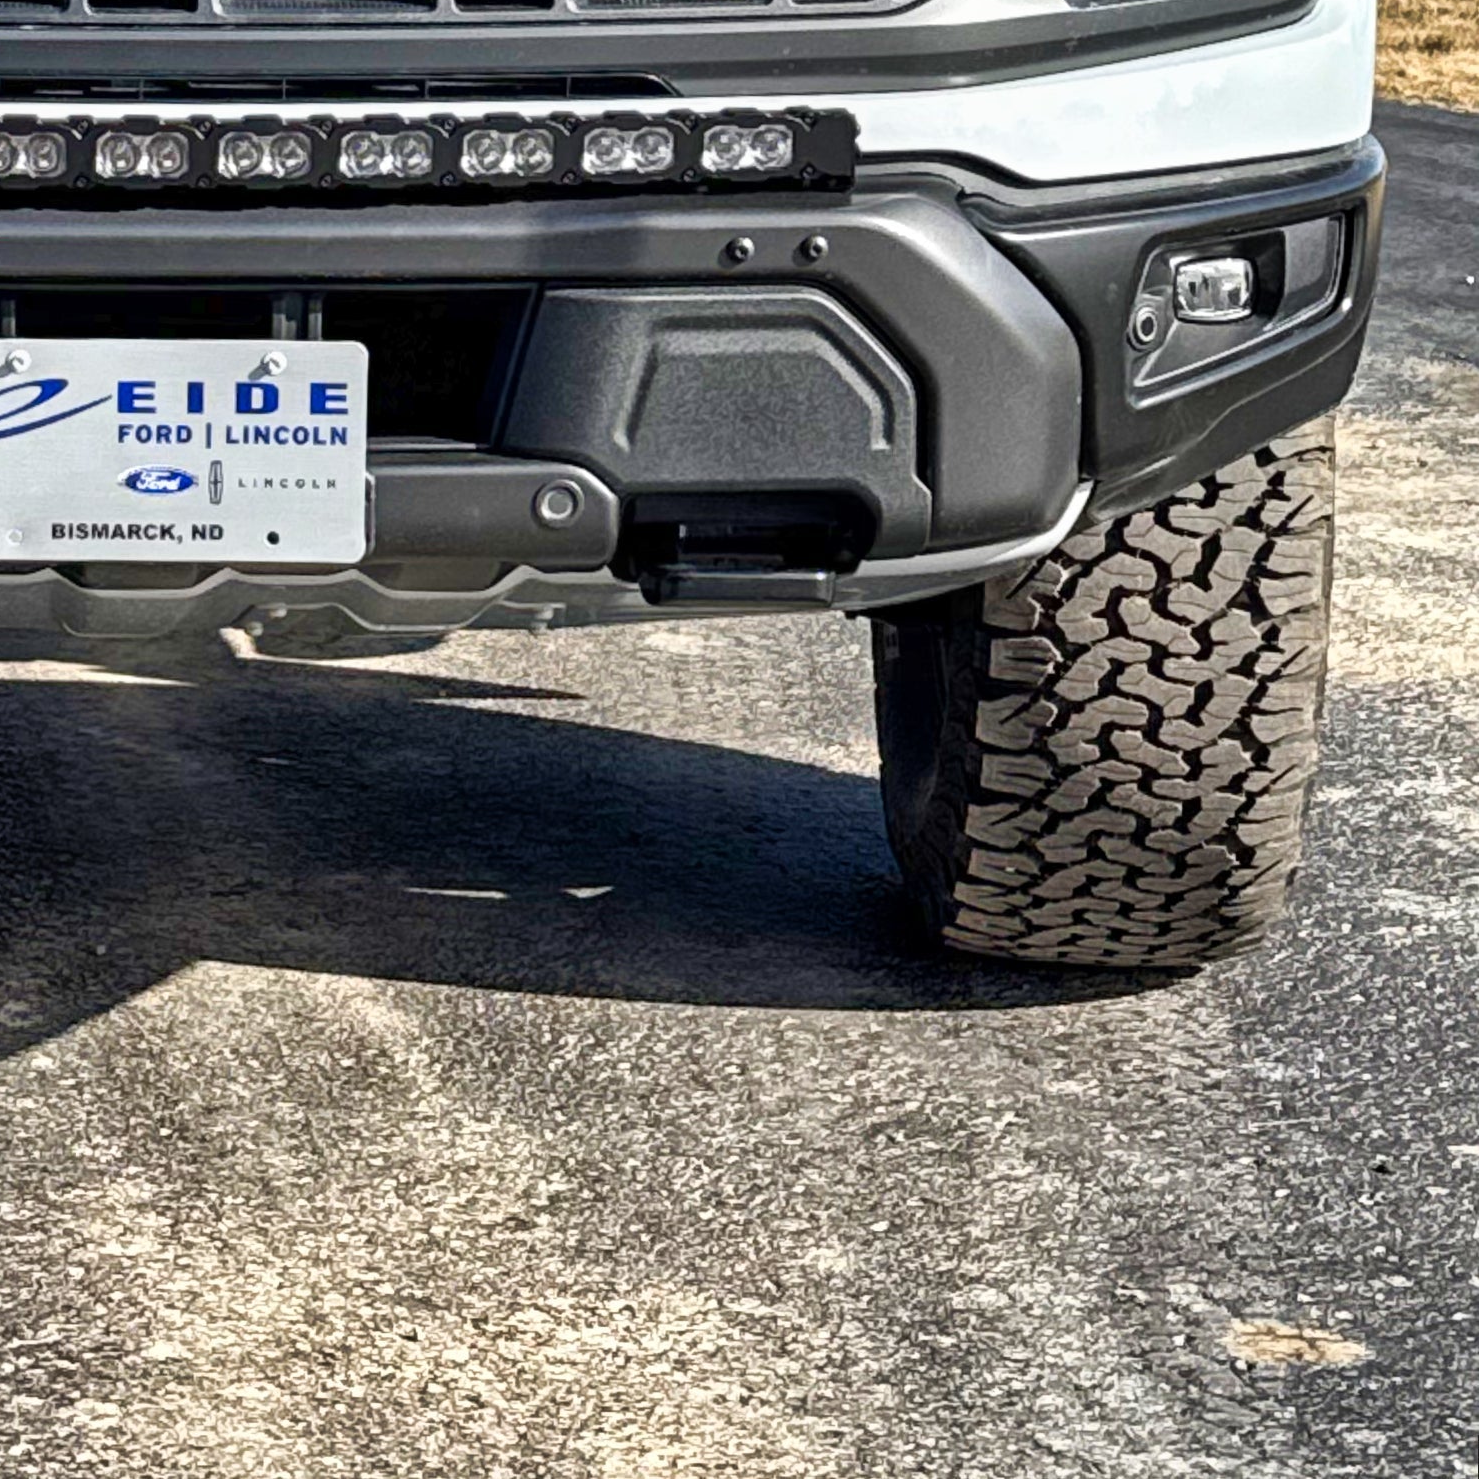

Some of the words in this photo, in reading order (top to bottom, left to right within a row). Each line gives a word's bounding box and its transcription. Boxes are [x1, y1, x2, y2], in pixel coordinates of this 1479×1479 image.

[117, 380, 349, 415] EIDE
[117, 424, 193, 444] FORD
[225, 424, 348, 445] LINCOLN
[136, 471, 181, 491] Ford
[237, 478, 337, 489] LINCOLN
[51, 523, 183, 543] BISMARCK,
[192, 524, 224, 541] ND
